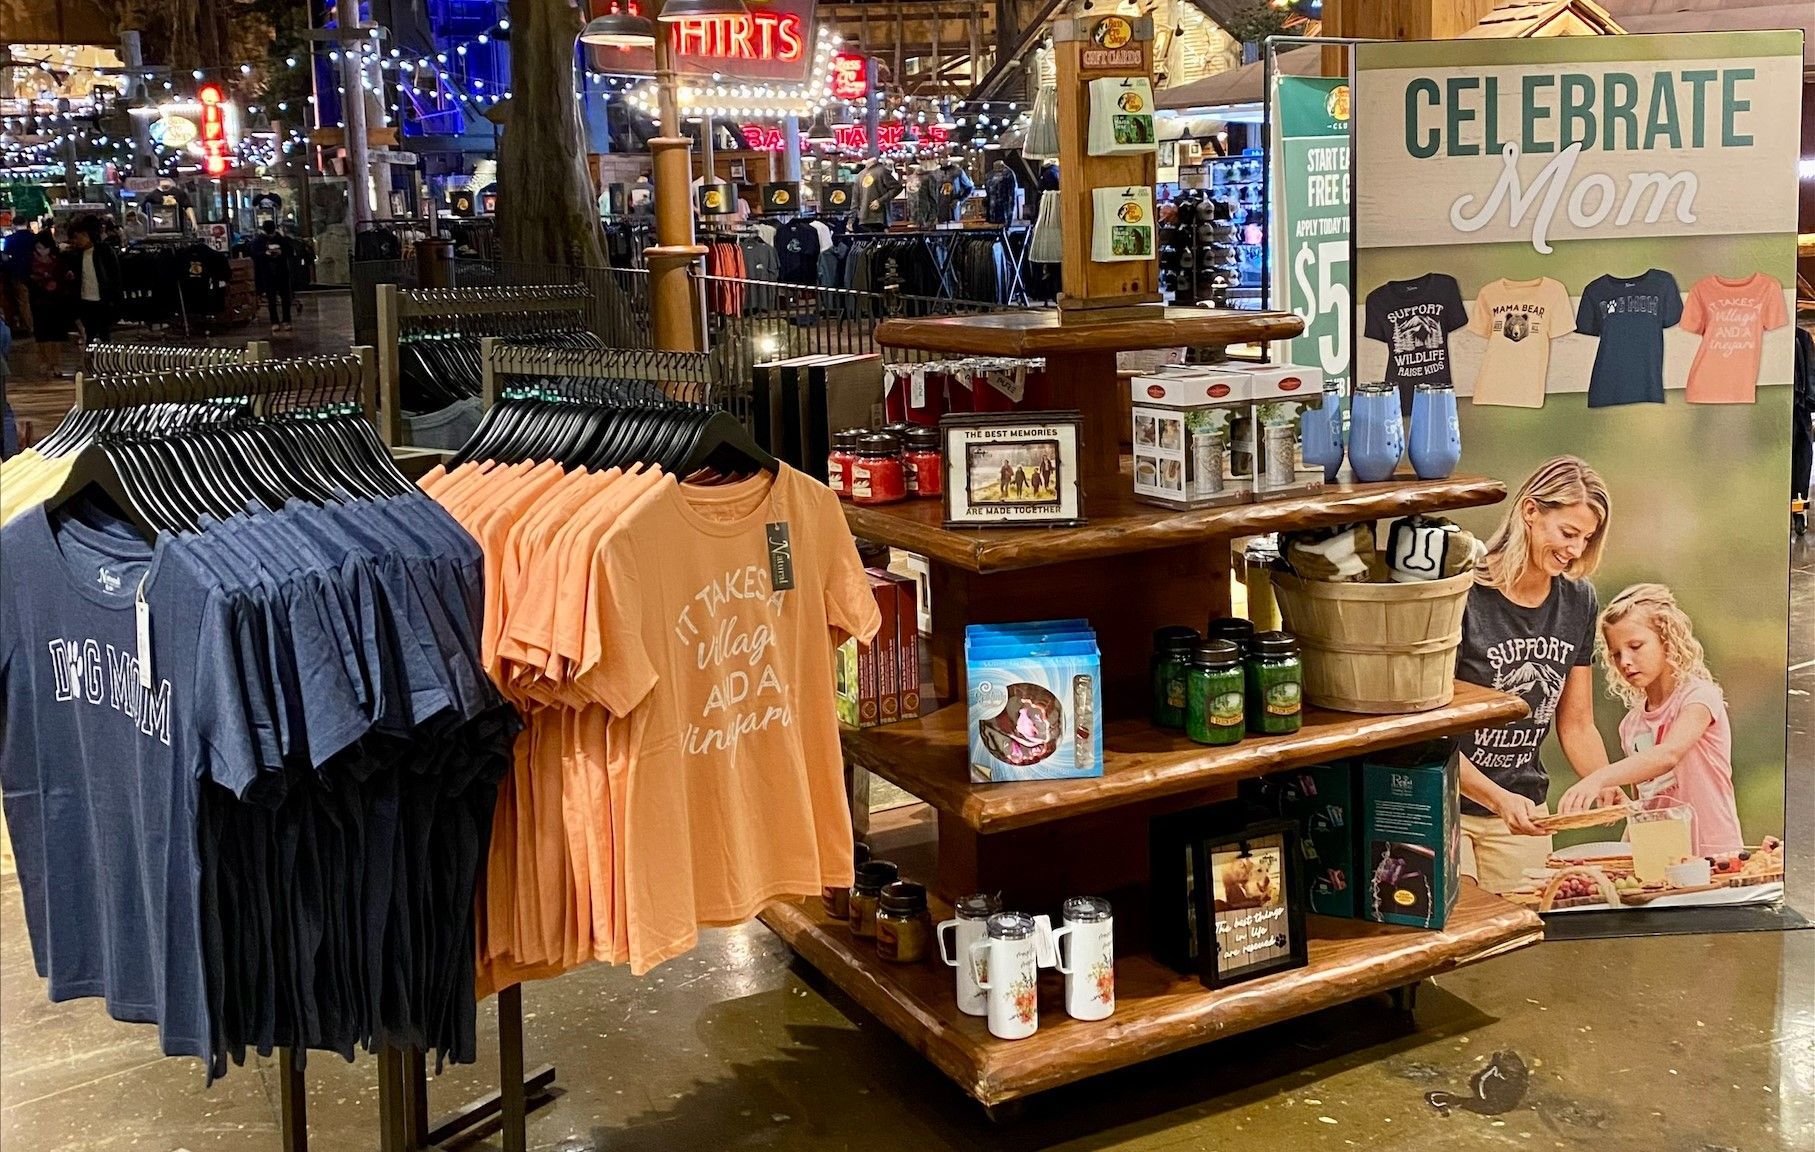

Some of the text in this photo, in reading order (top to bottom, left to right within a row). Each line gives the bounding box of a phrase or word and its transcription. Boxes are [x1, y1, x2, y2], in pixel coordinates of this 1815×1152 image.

[672, 11, 803, 63] HIRTS
[1083, 50, 1142, 65] GIFT CARDS
[1405, 68, 1755, 158] CELEBRATE
[1307, 147, 1337, 172] START
[1307, 173, 1340, 207] FREE
[1450, 141, 1699, 255] Mom
[1296, 219, 1318, 238] APPLY
[1319, 217, 1342, 236] TODAY
[1387, 304, 1444, 323] SUPPORT
[1493, 304, 1545, 318] MAMA BEAR
[1718, 297, 1754, 308] TAKES
[1753, 303, 1763, 313] A
[1715, 326, 1752, 338] AND A
[1394, 350, 1445, 367] WILDLIFE
[1397, 360, 1445, 377] RAISE KIDS
[965, 428, 1059, 439] THE BEST MEMORIES
[965, 505, 1061, 516] ARE MADE TOGETHER
[675, 566, 786, 646] IT TAKES A
[1487, 636, 1575, 669] SUPPORT
[756, 663, 782, 696] A
[1469, 747, 1516, 768] RAISE
